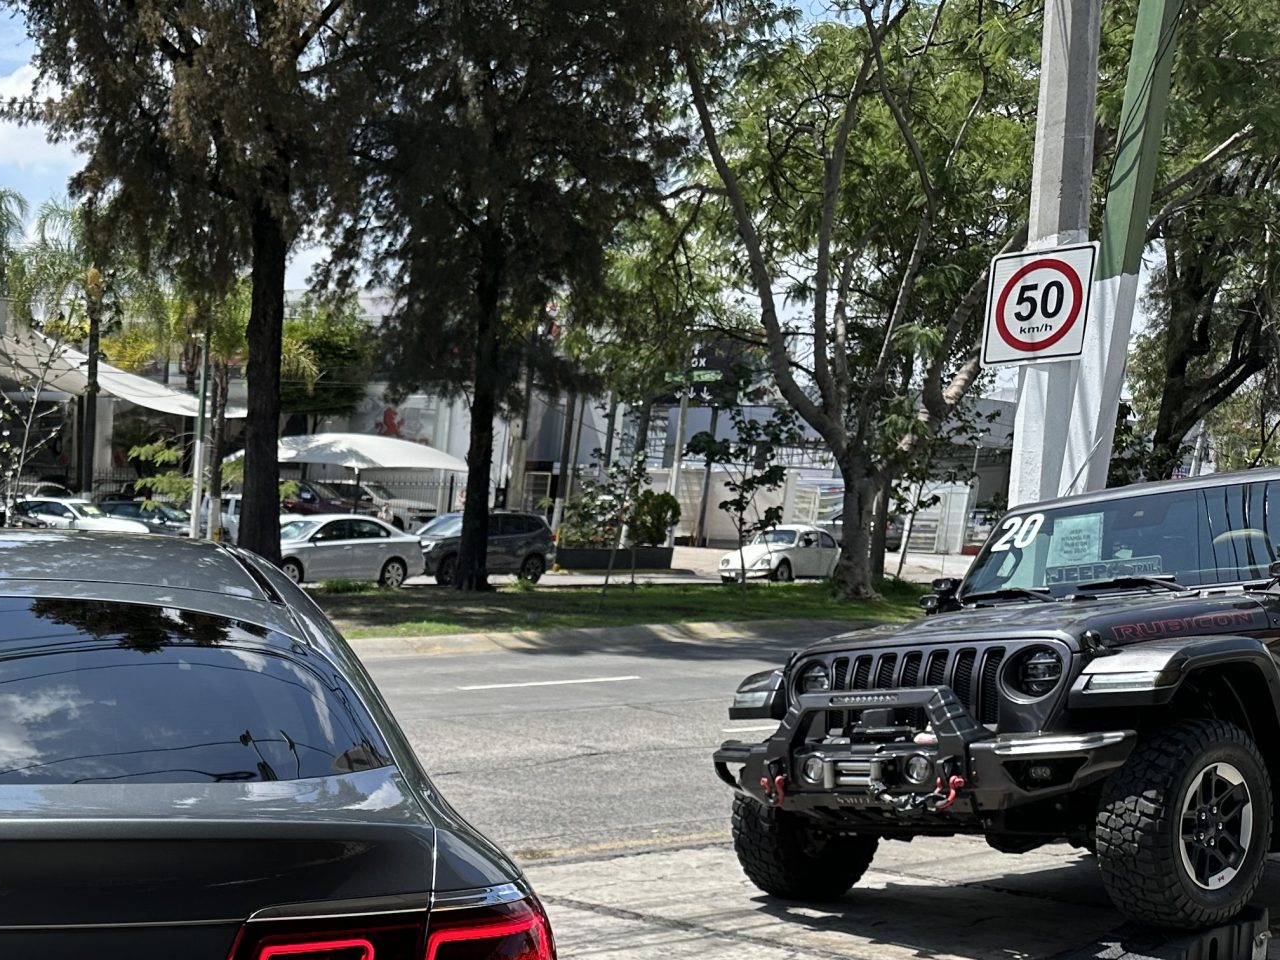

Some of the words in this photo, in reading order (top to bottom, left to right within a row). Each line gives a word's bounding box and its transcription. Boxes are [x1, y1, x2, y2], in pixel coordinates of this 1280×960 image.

[1014, 280, 1064, 321] 50
[1019, 323, 1053, 334] km/h
[991, 513, 1045, 552] 20
[1112, 613, 1256, 641] RUBICON
